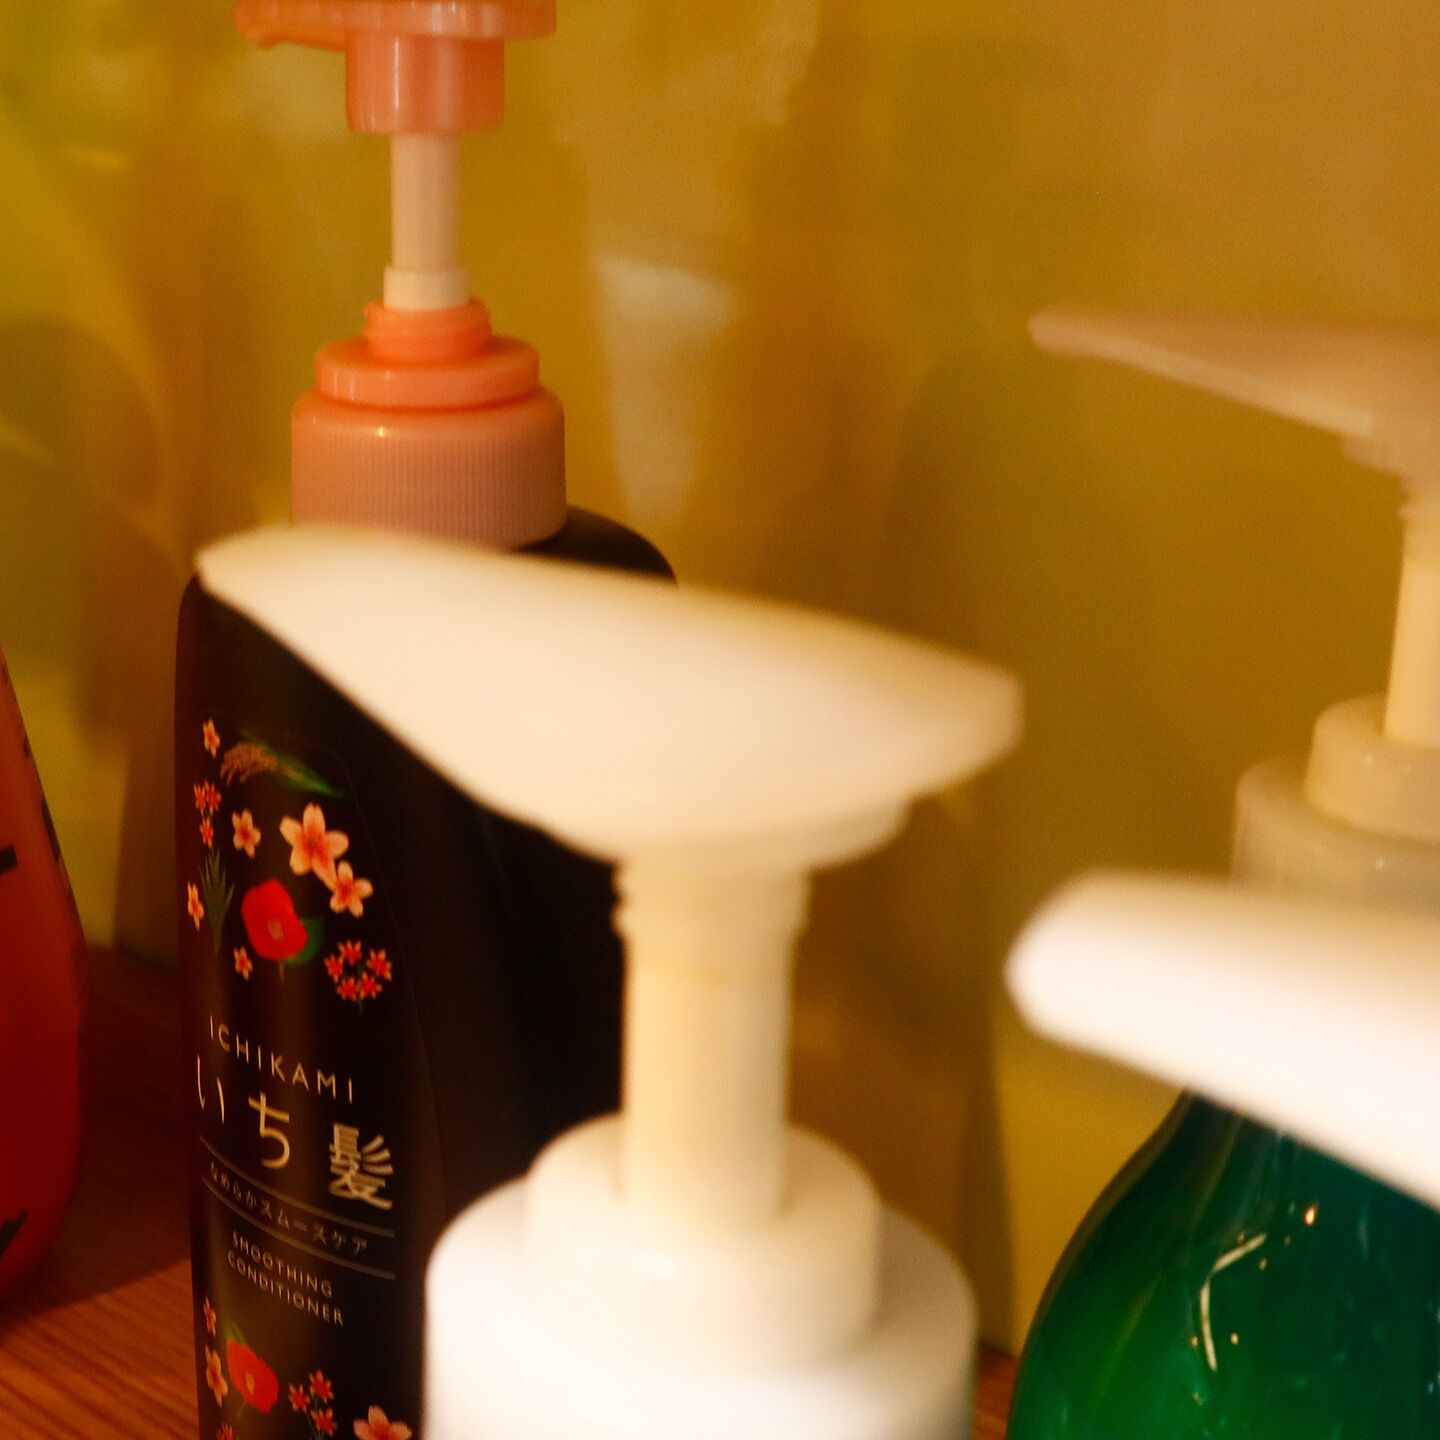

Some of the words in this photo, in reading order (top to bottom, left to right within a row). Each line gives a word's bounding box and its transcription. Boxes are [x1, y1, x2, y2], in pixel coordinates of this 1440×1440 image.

[210, 1015, 354, 1104] ICHIKAMI
[197, 1053, 395, 1211] いち髪
[227, 1250, 344, 1327] CONDITIONER
[232, 1230, 333, 1298] SMOOTHING
